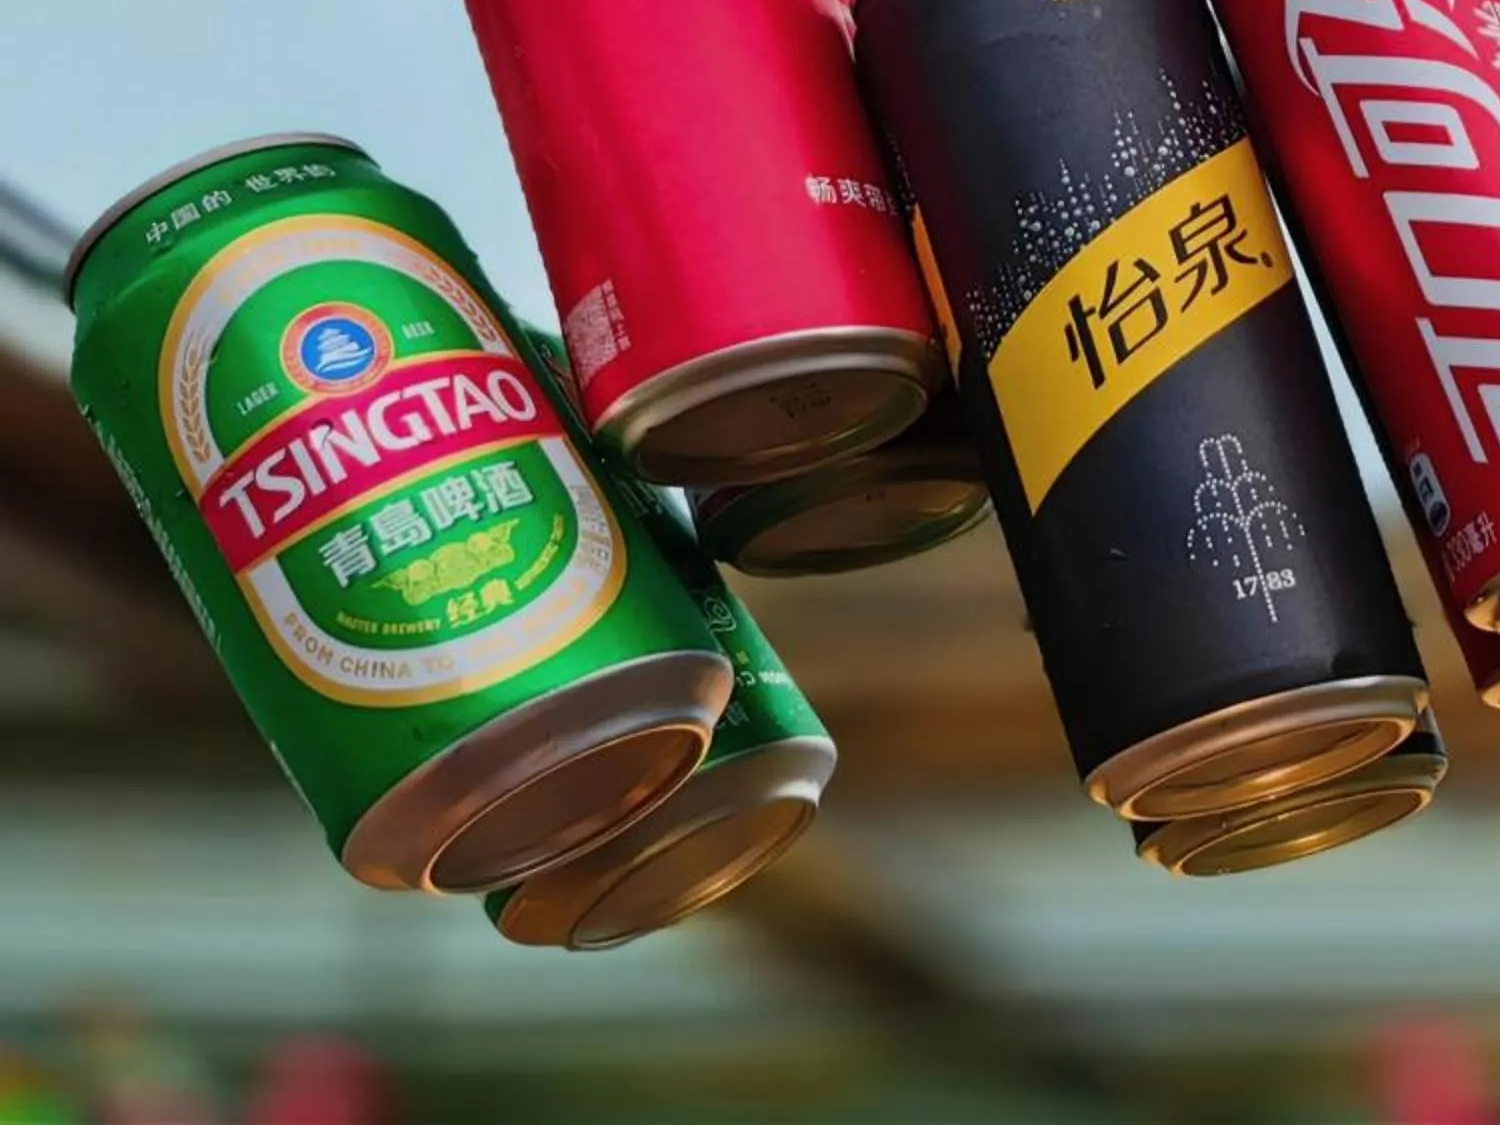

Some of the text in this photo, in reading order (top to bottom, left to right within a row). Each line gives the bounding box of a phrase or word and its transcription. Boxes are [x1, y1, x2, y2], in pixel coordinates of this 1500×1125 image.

[1064, 194, 1275, 392] 怡泉
[219, 370, 537, 539] TSINGTAO
[318, 460, 534, 588] 青島啤酒
[283, 612, 334, 667] FROM
[340, 655, 414, 680] CHINA
[446, 578, 514, 629] 经典
